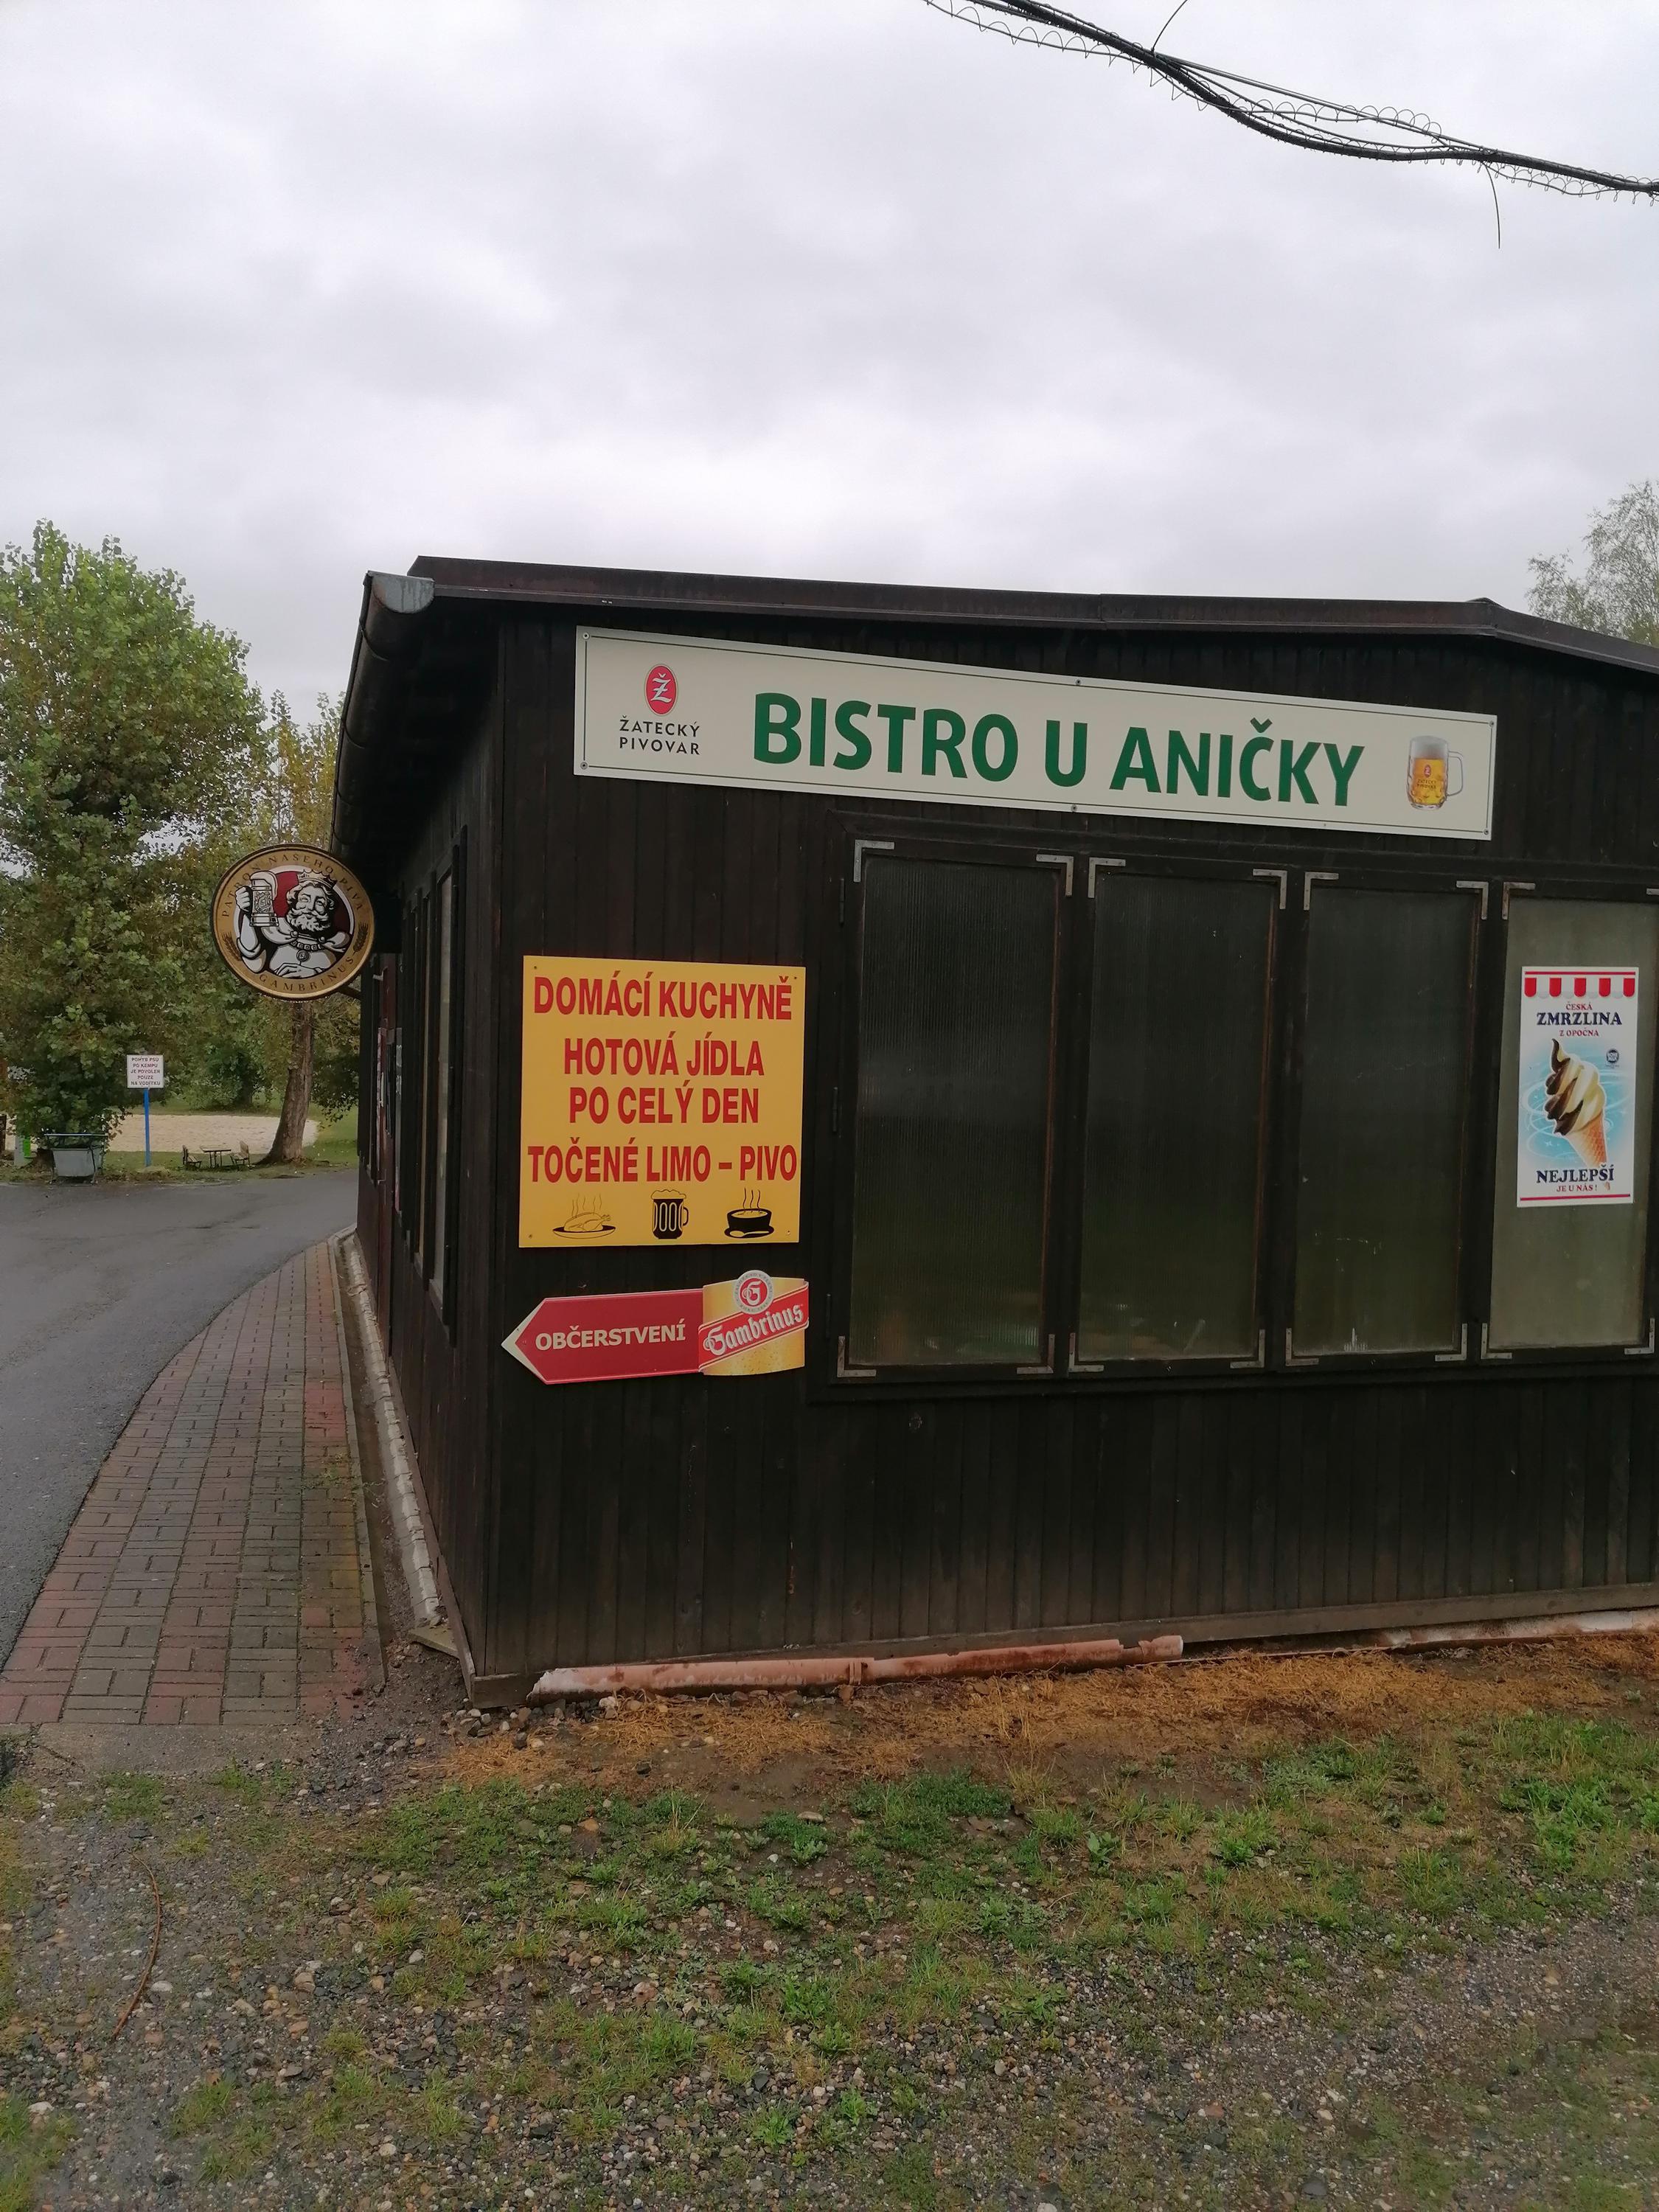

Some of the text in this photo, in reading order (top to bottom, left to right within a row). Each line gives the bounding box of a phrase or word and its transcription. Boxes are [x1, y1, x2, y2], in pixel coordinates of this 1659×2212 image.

[619, 714, 700, 738] ŽATECKÝ
[619, 737, 700, 755] PIVOVAR
[754, 692, 1366, 807] BISTRO U ANIČKY
[259, 956, 354, 992] GAMBRINUS
[534, 970, 793, 1020] DOMÁCÍ KUCHYNĚ
[1565, 1001, 1593, 1011] ČESKÁ
[1536, 1011, 1623, 1026] ZMRZLINA
[1566, 1027, 1599, 1037] OPOČNA
[564, 1031, 765, 1077] HOTOVÁ JÍDLA
[569, 1079, 759, 1124] PO CELÝ DEN
[527, 1137, 639, 1183] TOČENÉ
[646, 1145, 712, 1182] LIMO
[740, 1144, 798, 1181] PIVO
[1536, 1164, 1615, 1183] NEJLEPŠÍ
[535, 1318, 686, 1351] OBČERSTVENÍ
[703, 1304, 804, 1356] Gambrinus
